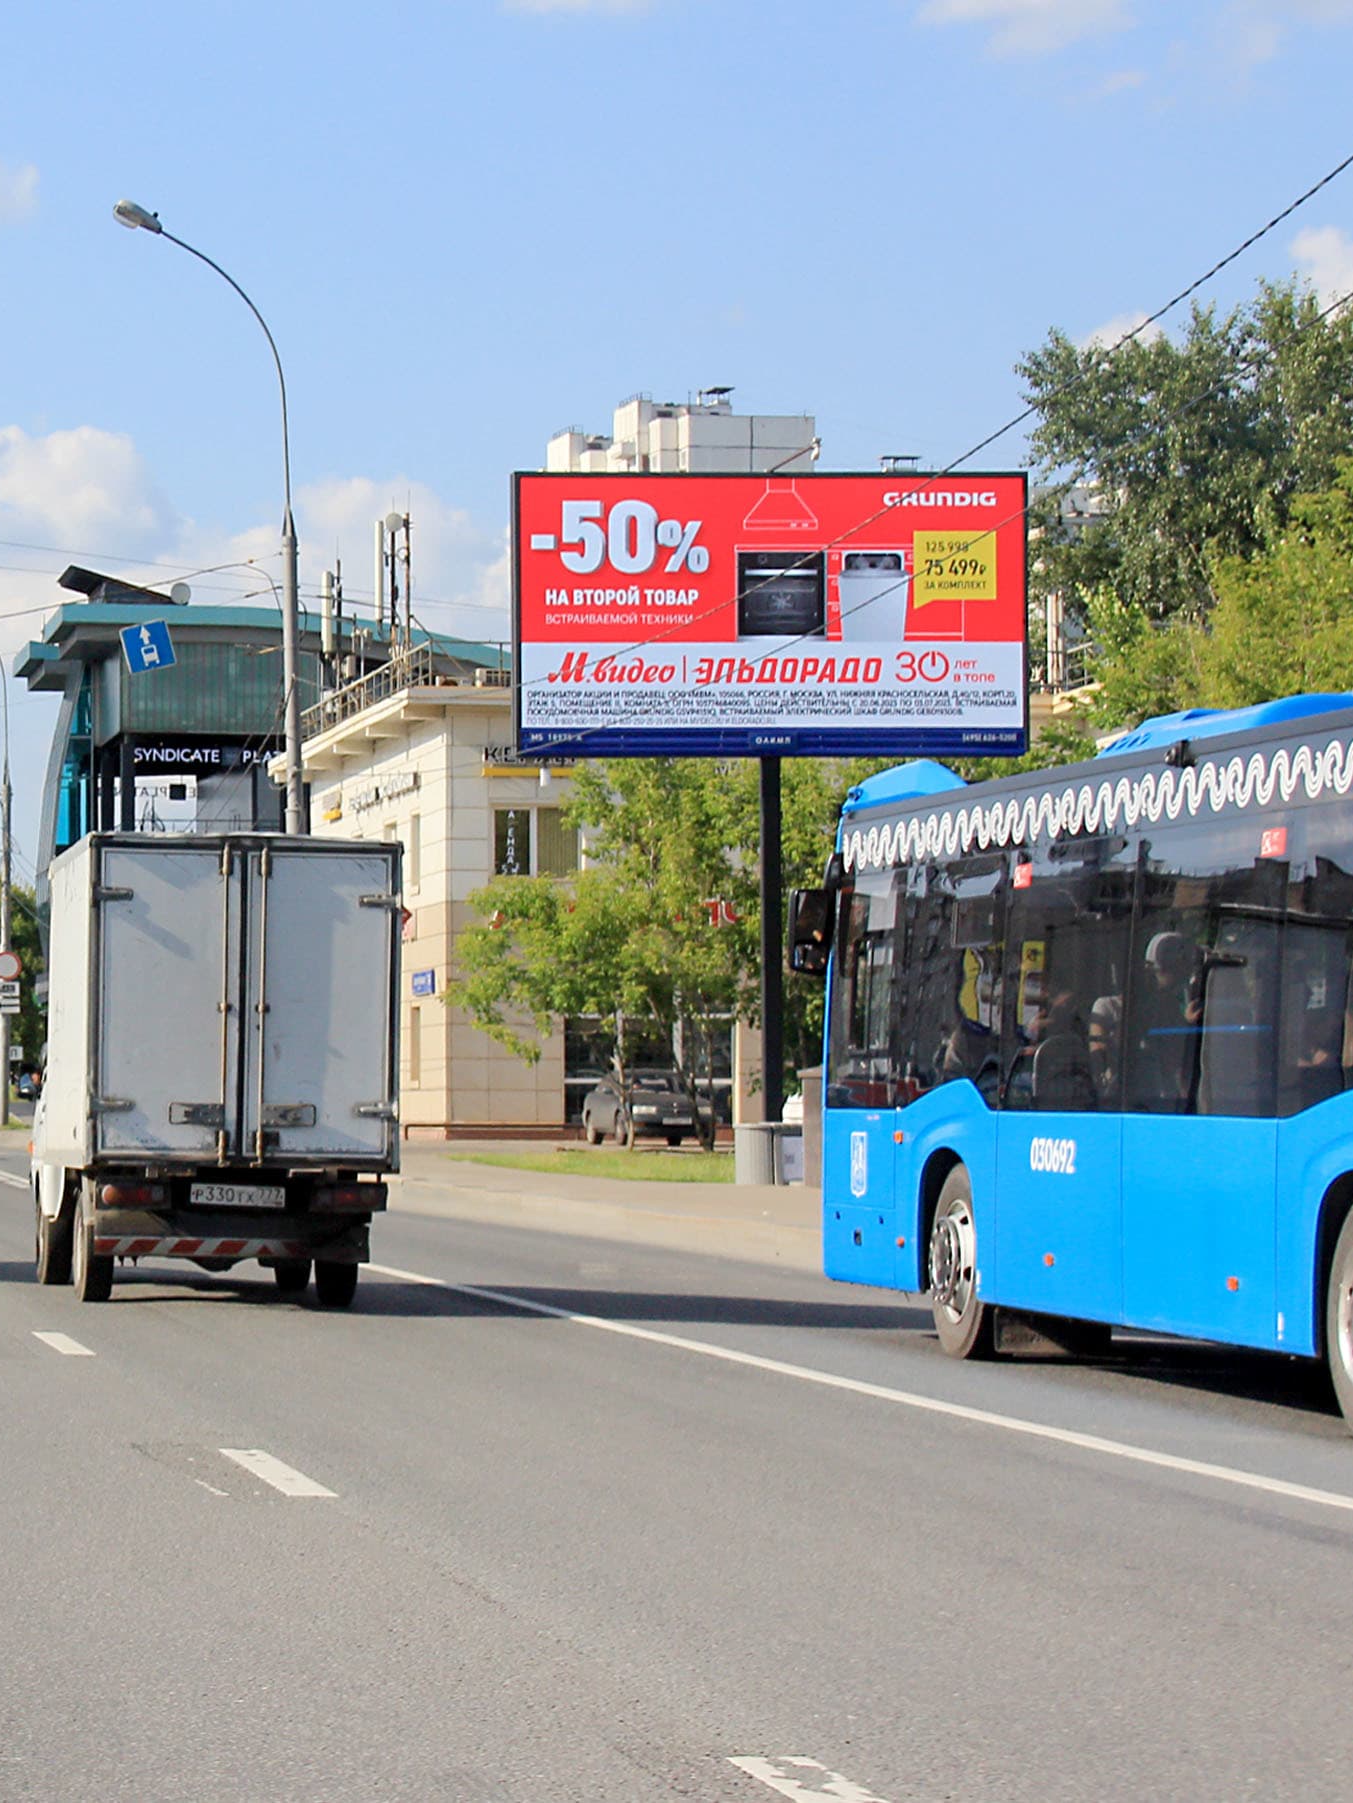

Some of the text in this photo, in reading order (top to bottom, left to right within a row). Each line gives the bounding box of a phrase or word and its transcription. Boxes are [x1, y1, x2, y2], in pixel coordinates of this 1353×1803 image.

[883, 491, 997, 507] GRUNDIG
[530, 499, 711, 574] -50%
[938, 580, 987, 590] КОМПЛЕКТ
[545, 585, 700, 606] НА ВТОРОЙ ТОВАР
[545, 612, 694, 625] ВСТРАИВАЕМОЙ ТЕХНИКИ
[692, 657, 882, 684] ЭЛЬДОРАДО
[895, 650, 951, 683] 30
[953, 659, 978, 669] лет
[953, 672, 996, 683] в топе
[134, 747, 221, 764] SYNDICATE
[1030, 1137, 1078, 1175] 030692
